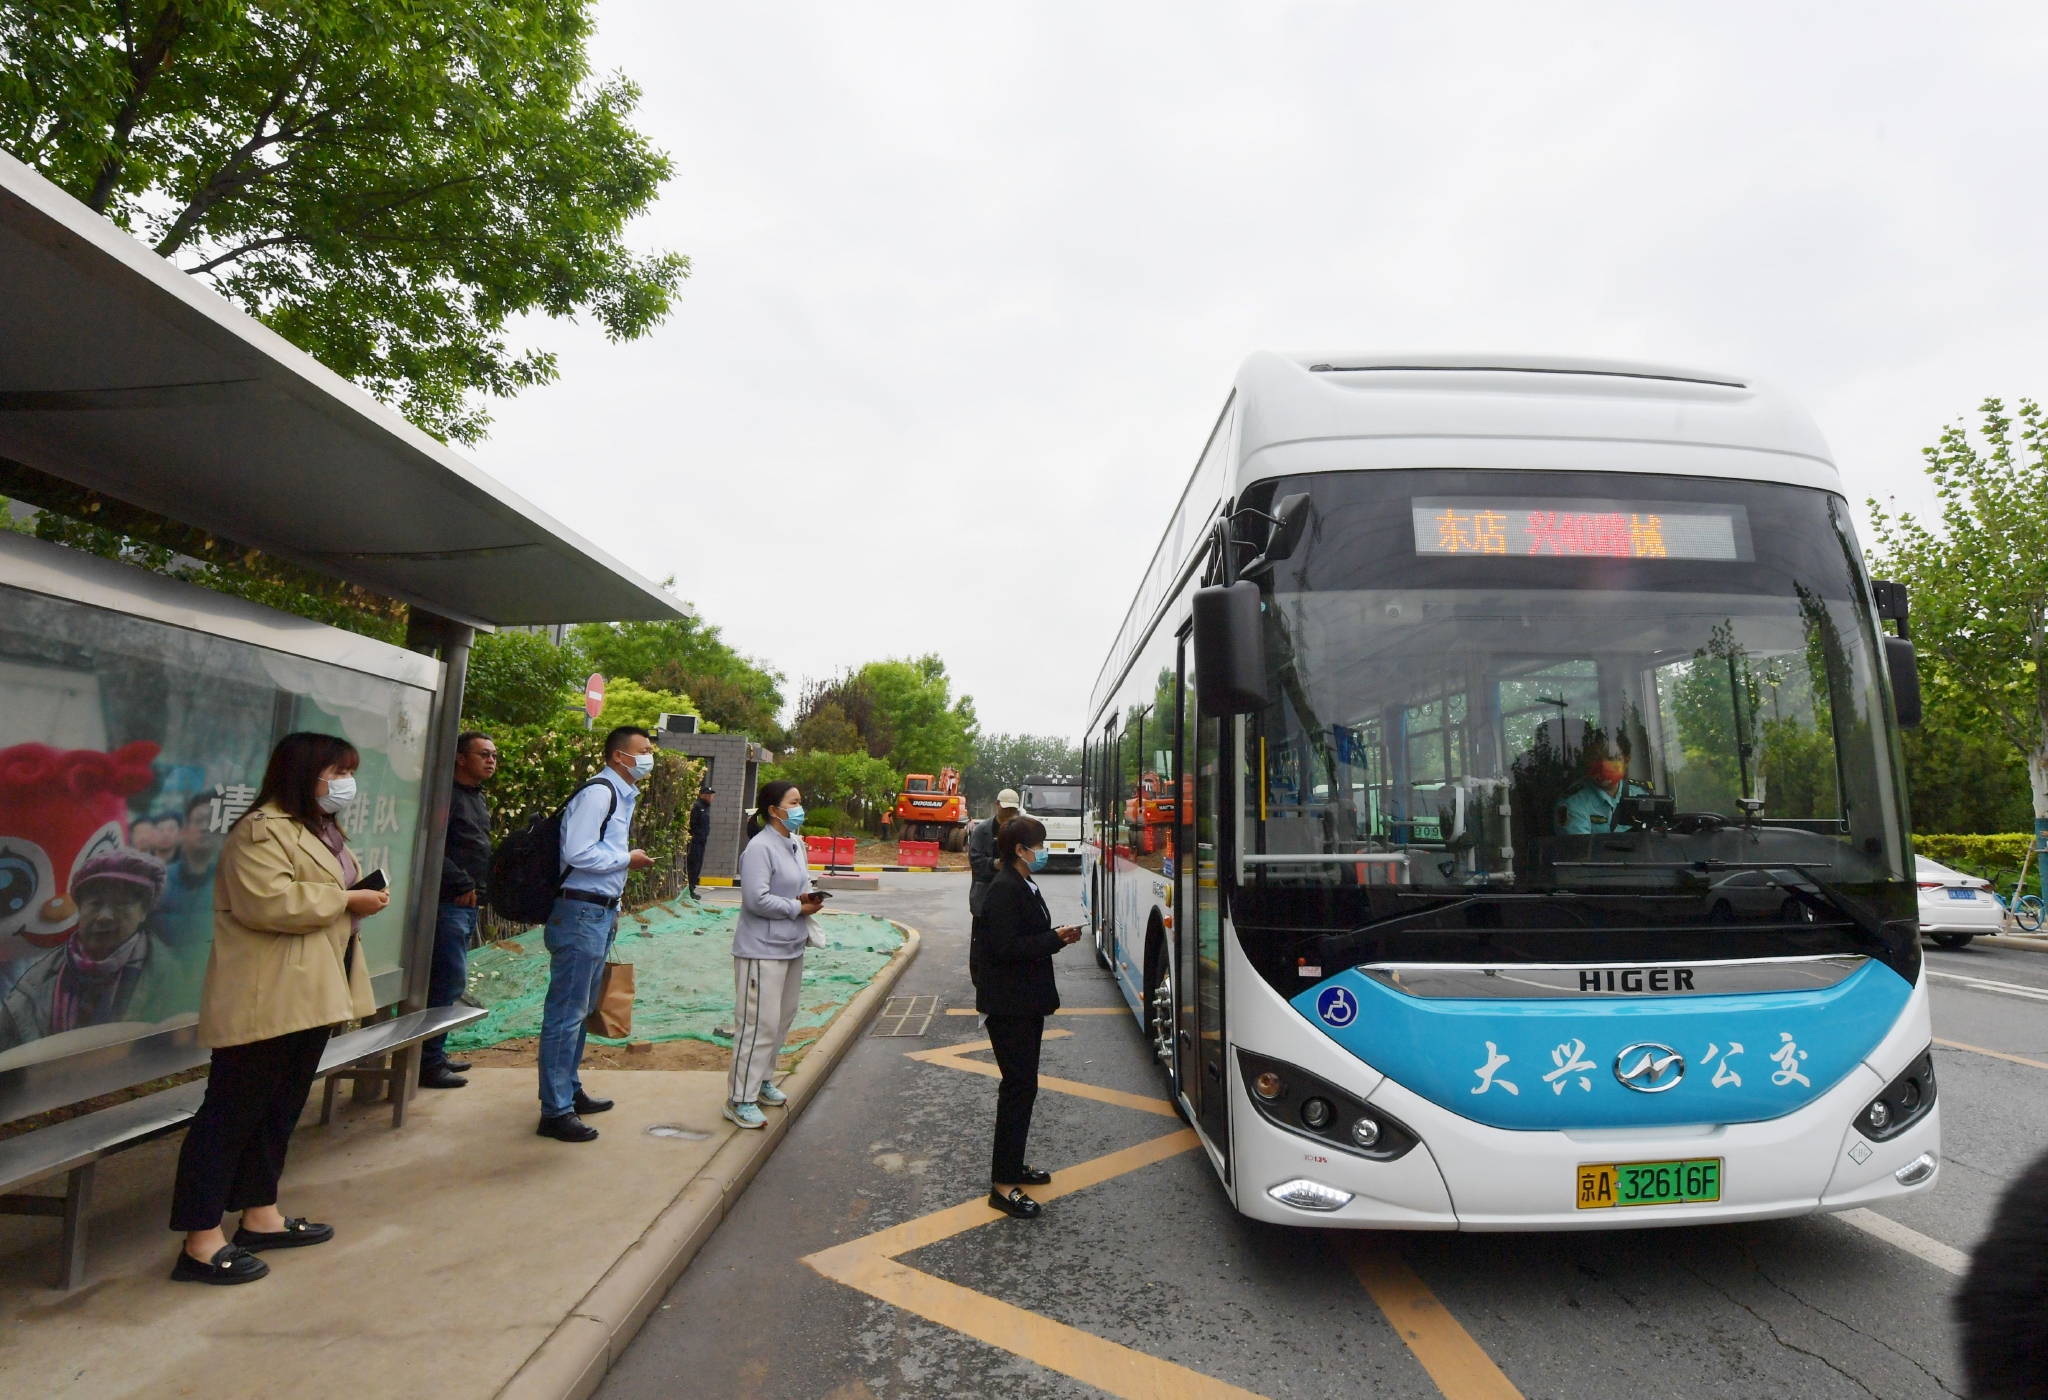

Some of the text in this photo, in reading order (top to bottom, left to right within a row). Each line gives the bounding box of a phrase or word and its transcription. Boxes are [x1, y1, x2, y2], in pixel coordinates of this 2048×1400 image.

[1437, 509, 1506, 554] 东店
[1579, 969, 1695, 992] HIGER
[1471, 1032, 1811, 1096] 大兴 公交
